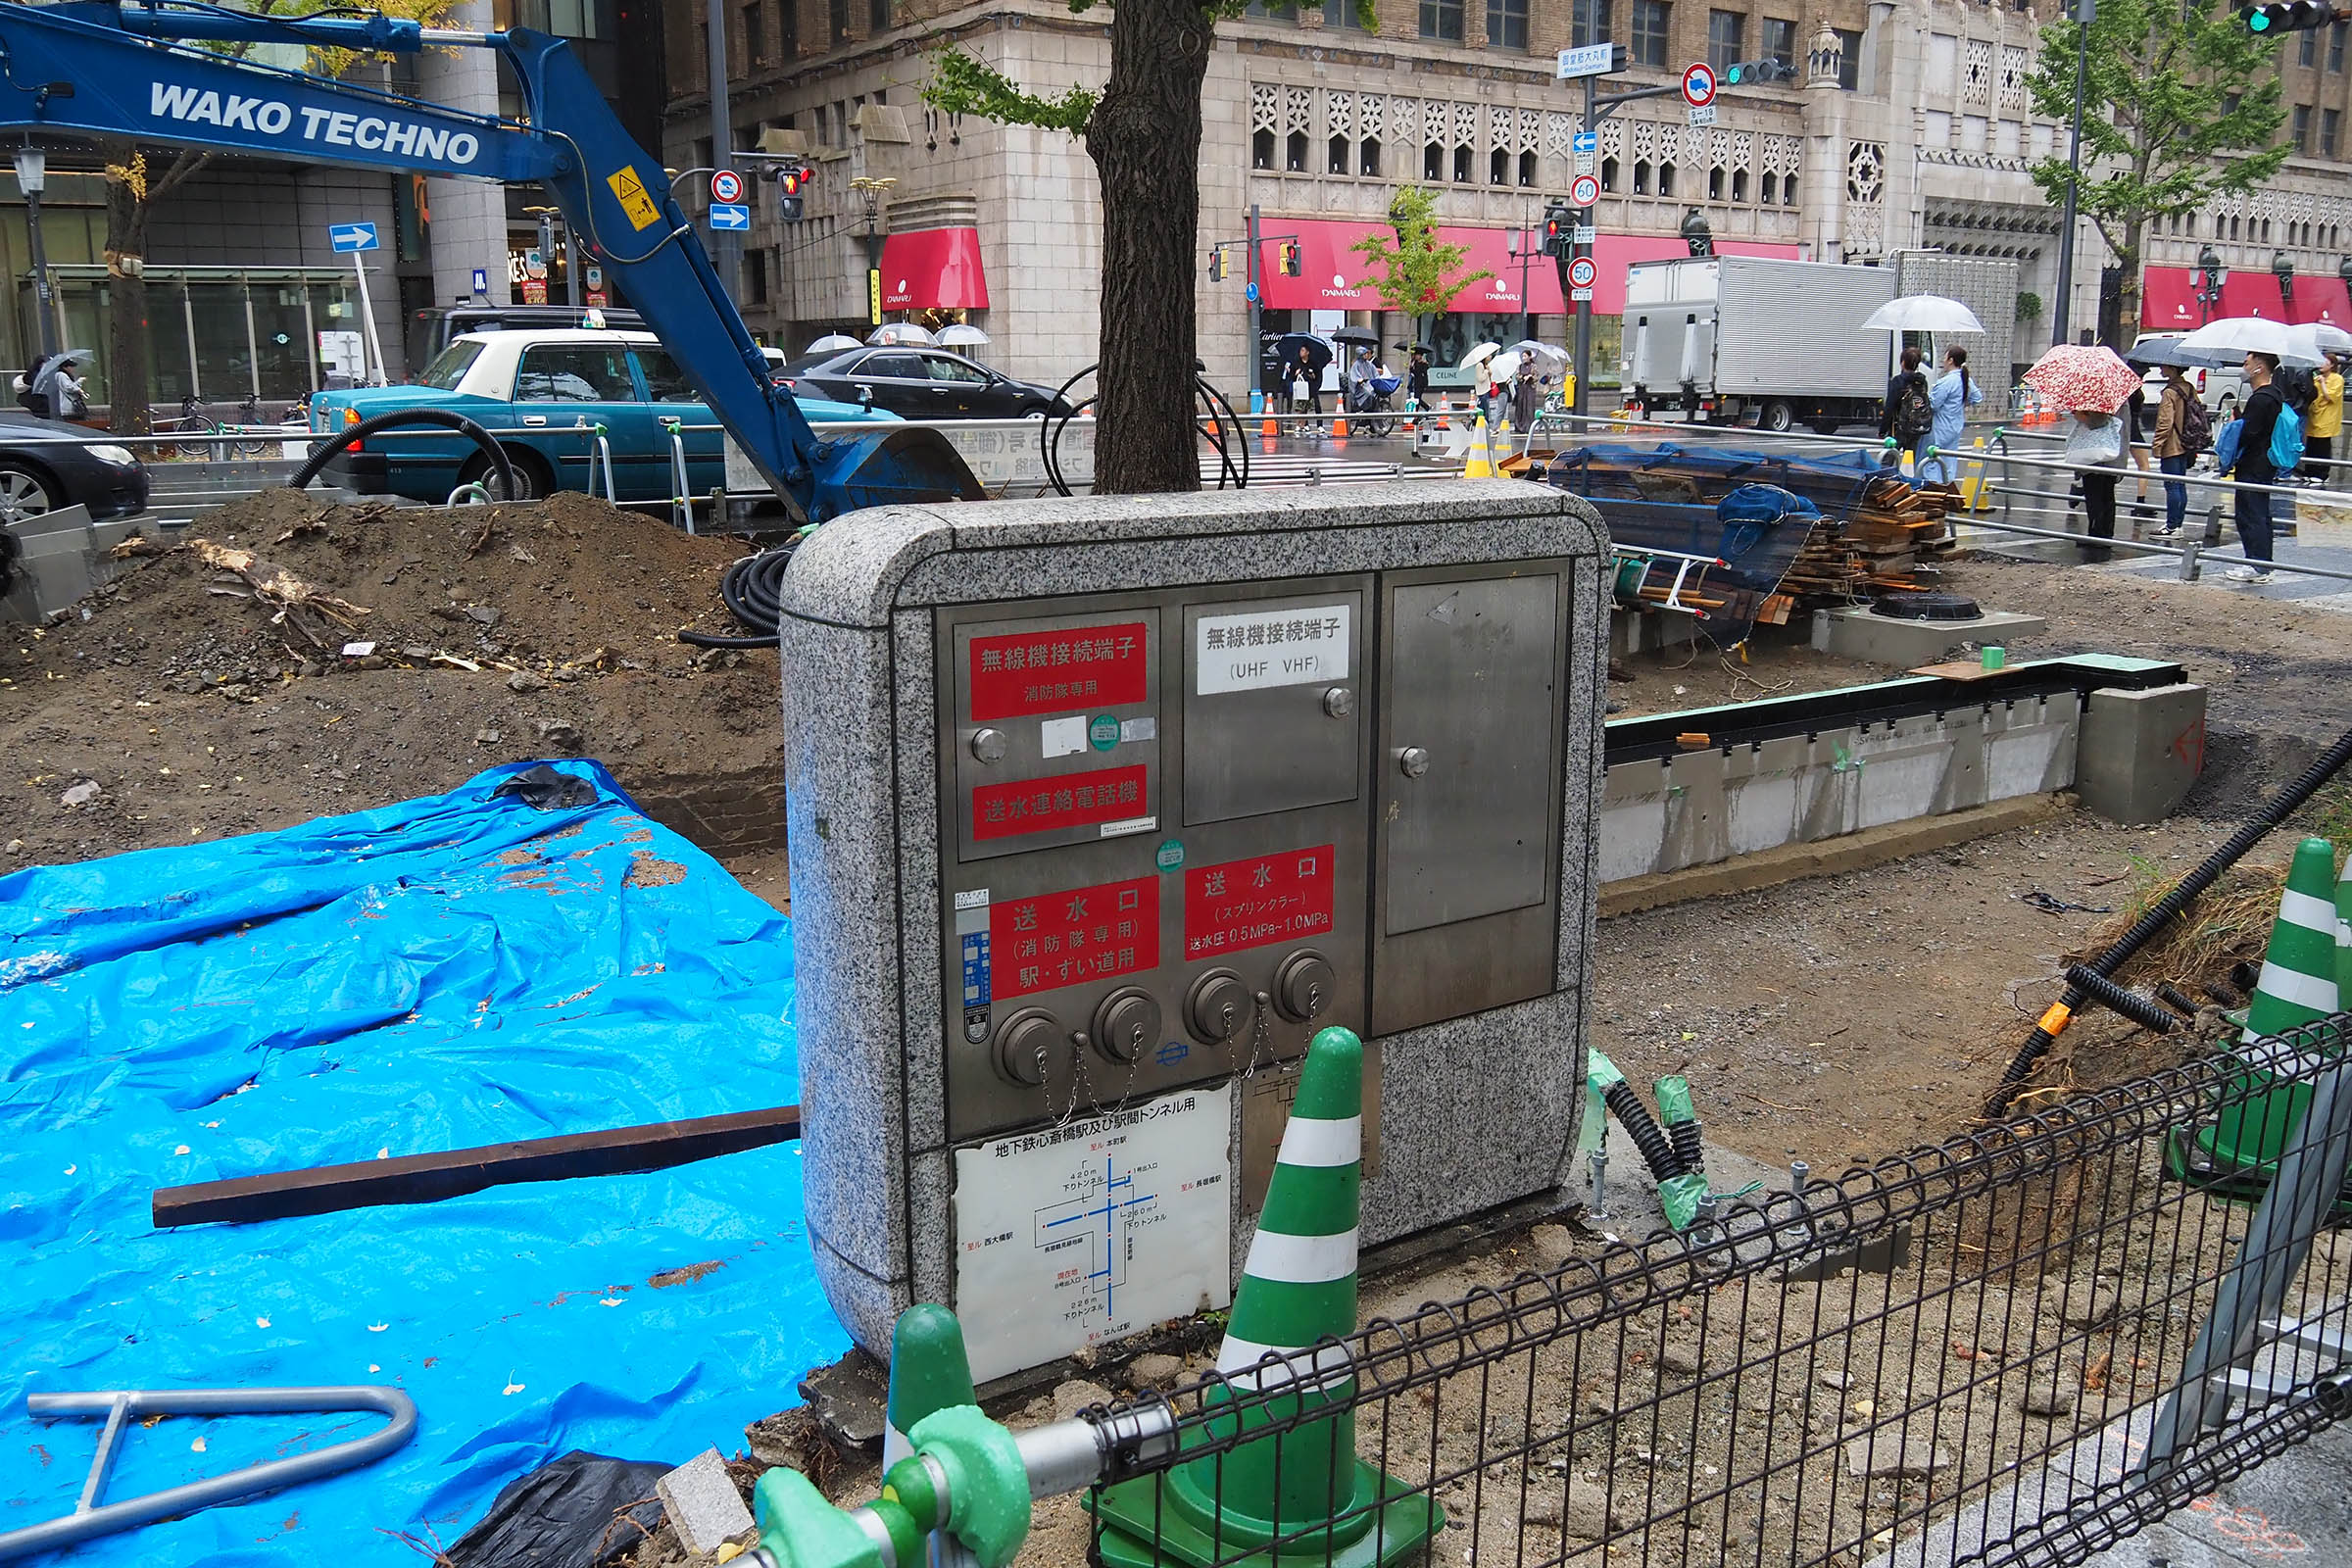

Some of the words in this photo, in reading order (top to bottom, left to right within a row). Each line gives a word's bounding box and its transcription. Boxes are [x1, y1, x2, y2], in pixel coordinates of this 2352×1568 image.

[151, 82, 292, 135] WAKO
[300, 107, 479, 165] TECHNO
[1577, 183, 1594, 197] 60
[1574, 266, 1592, 279] 50
[887, 293, 912, 303] DAIMARU
[1321, 289, 1361, 298] DAIMARU
[1486, 292, 1521, 301] DAIMARU
[1206, 617, 1341, 651] 無線機接続端子
[981, 636, 1137, 672] 無線機接続端子
[1230, 661, 1269, 680] (UHF
[1283, 655, 1319, 674] VHF)
[1024, 679, 1099, 704] 消防隊専用
[984, 779, 1139, 822] 送水連絡電話機
[1214, 891, 1307, 923] (スプリンクラー)
[1012, 919, 1139, 960] (消防隊専用)
[1190, 931, 1225, 951] 送水圧
[1019, 948, 1136, 989] 駅・ずい道用
[1090, 1142, 1104, 1152] 至ル
[1106, 1136, 1128, 1148] 本町駅
[1069, 1168, 1098, 1180] 420m
[1062, 1175, 1104, 1193] 下りトンネル
[1180, 1182, 1195, 1193] 至ル
[1127, 1206, 1153, 1219] 260m
[1127, 1214, 1167, 1230] 下りトンネル
[966, 1242, 982, 1251] 至ル
[984, 1232, 1013, 1247] 西大橋駅
[1064, 1304, 1104, 1321] 下りトンネル
[1103, 1322, 1131, 1336] なんば駅
